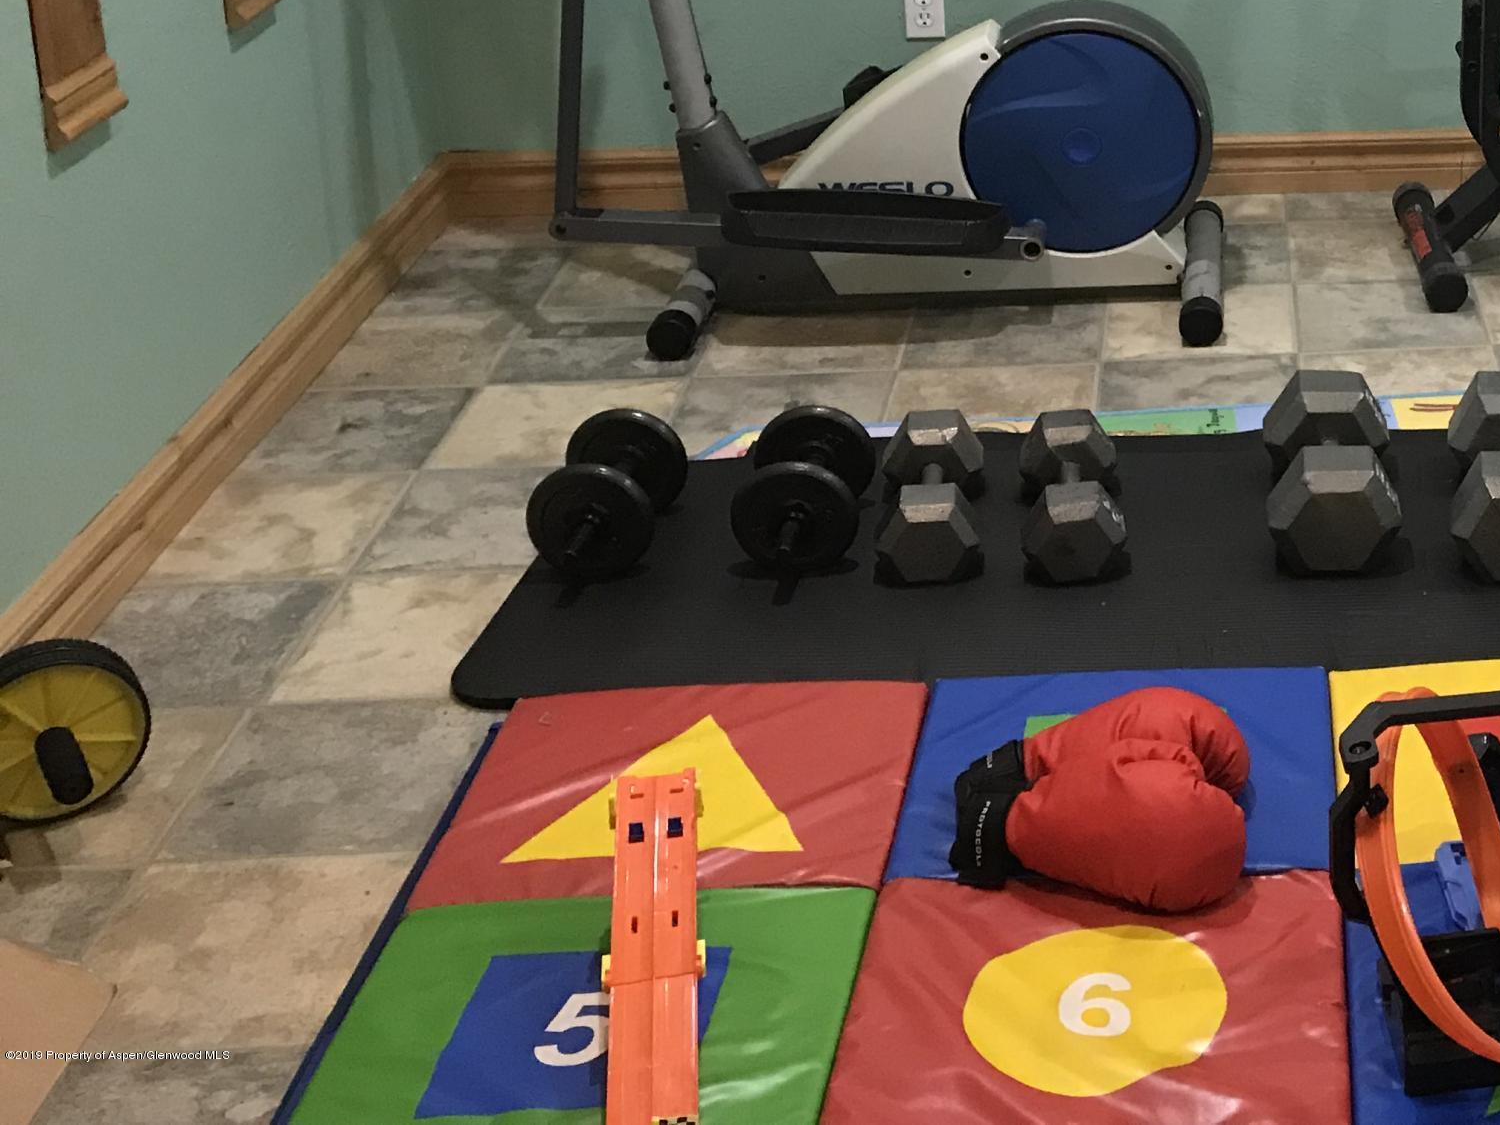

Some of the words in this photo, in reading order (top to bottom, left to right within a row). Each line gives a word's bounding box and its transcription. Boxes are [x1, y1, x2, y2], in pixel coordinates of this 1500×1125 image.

[975, 800, 992, 864] PROTOCOL
[534, 992, 610, 1067] 5
[1059, 972, 1132, 1037] 6
